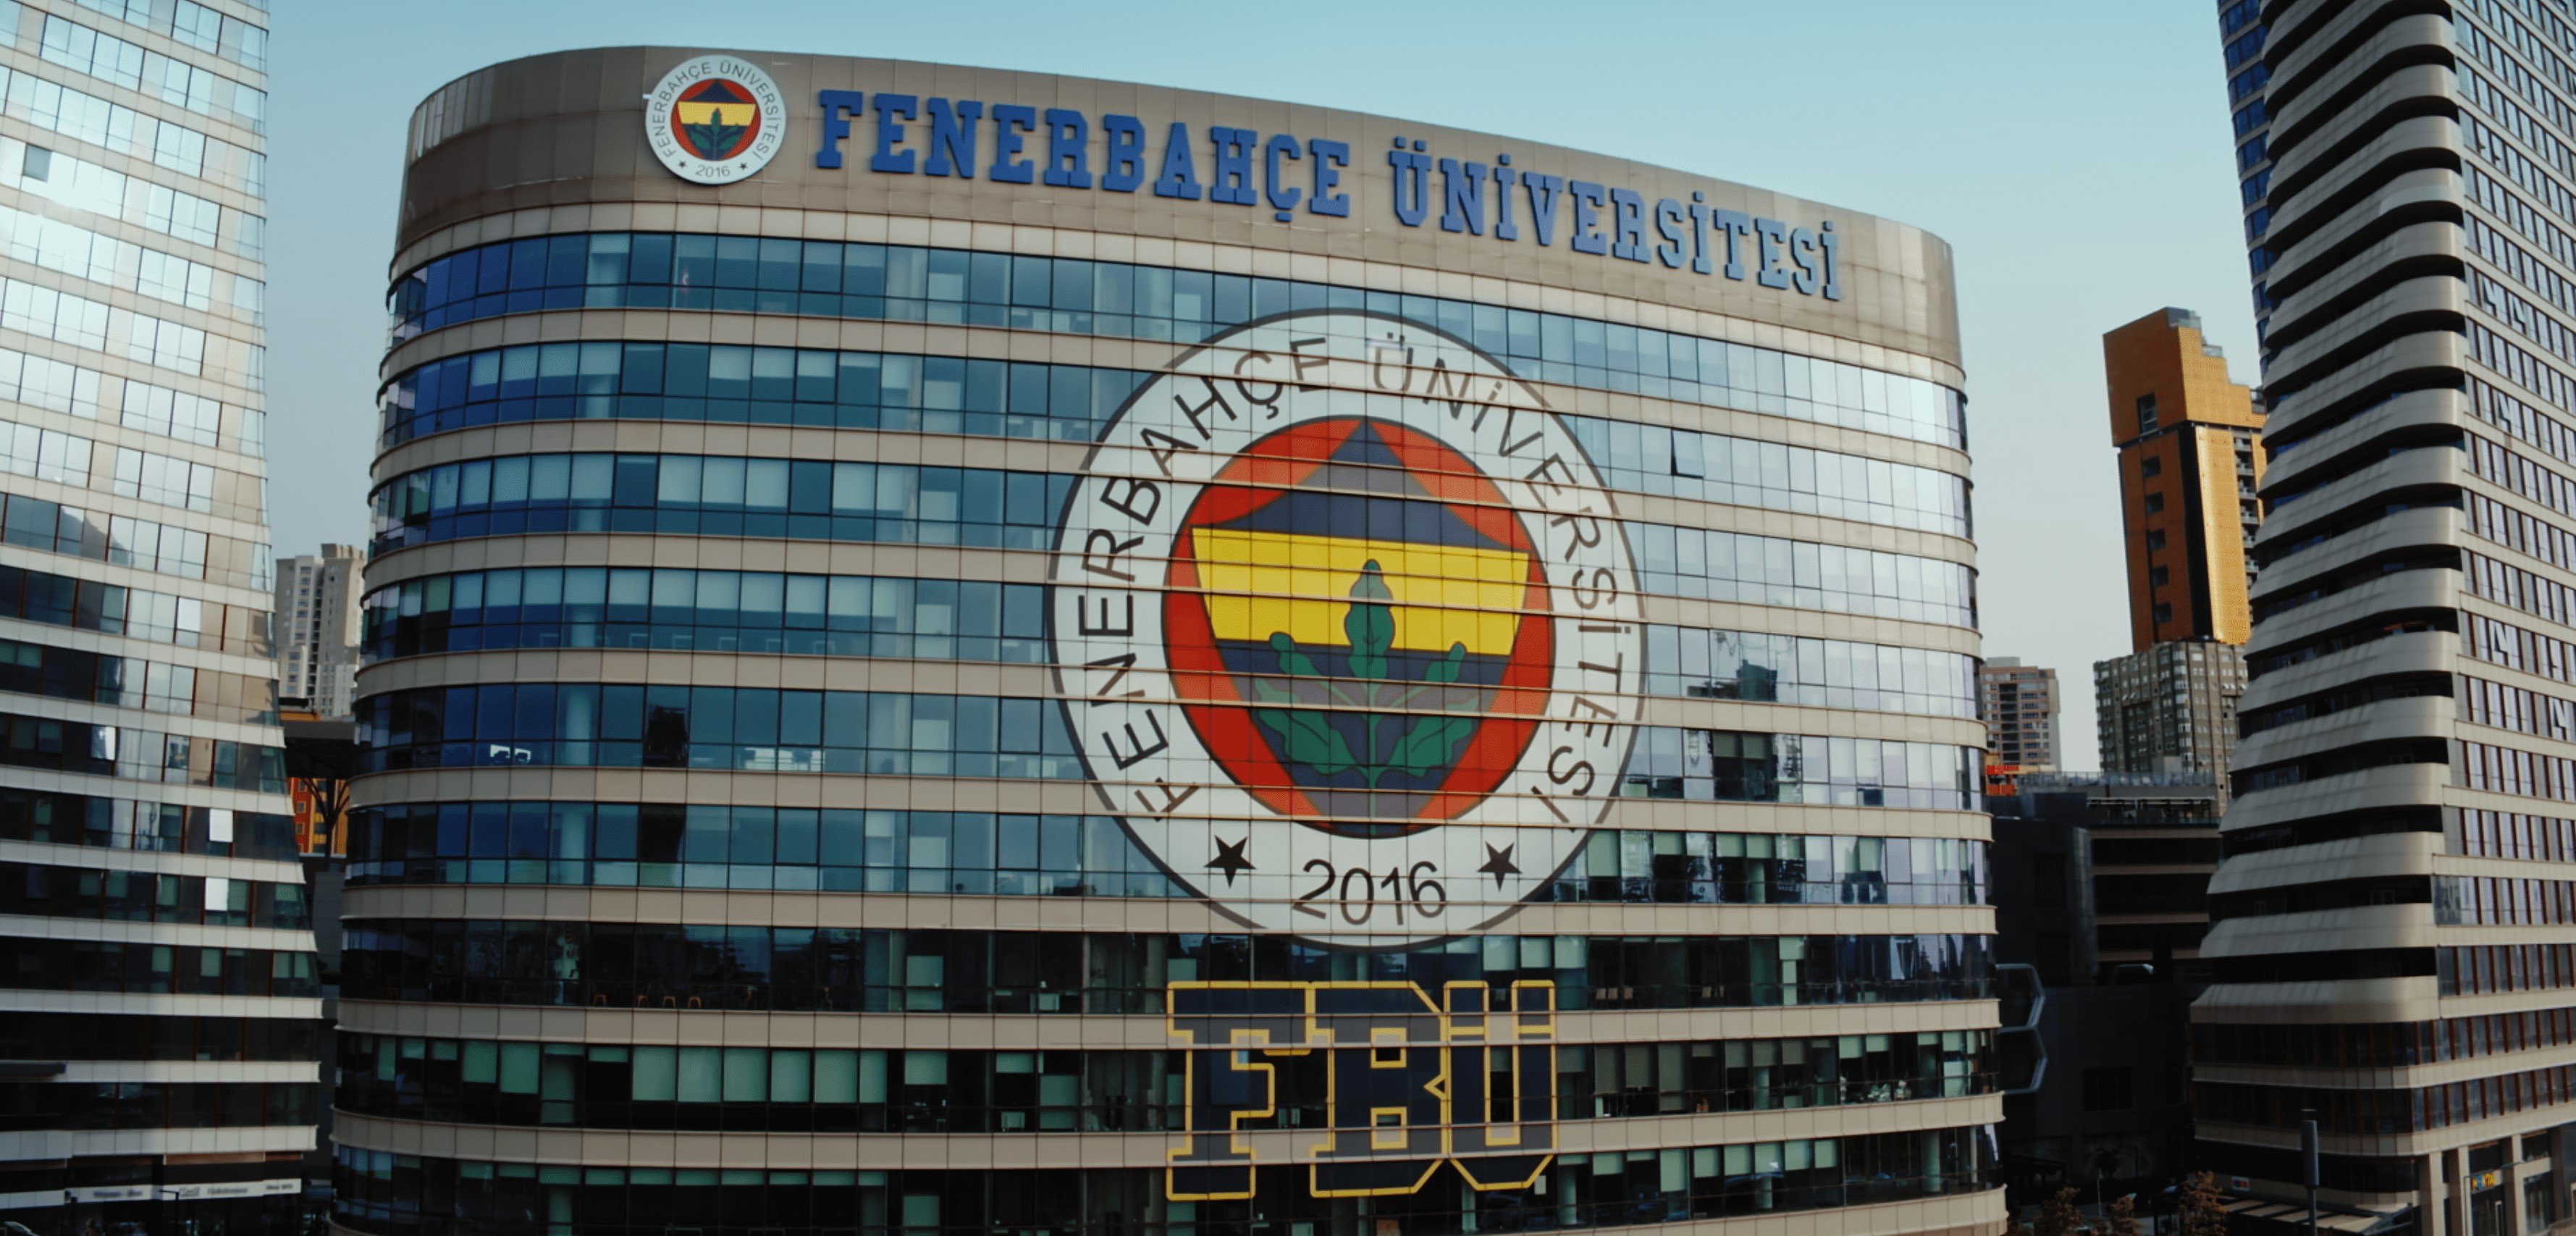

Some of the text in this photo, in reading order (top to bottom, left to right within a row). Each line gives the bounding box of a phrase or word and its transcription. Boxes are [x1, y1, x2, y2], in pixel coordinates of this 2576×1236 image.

[653, 62, 712, 158] FENERBAHÇE
[695, 164, 731, 178] 2016
[816, 89, 1841, 300] FENERBAHÇE ÜNİVERSİTESİ
[1077, 332, 1632, 833] FENERBAHÇE ÜNİVERSİTESİ
[1292, 859, 1447, 926] 2016
